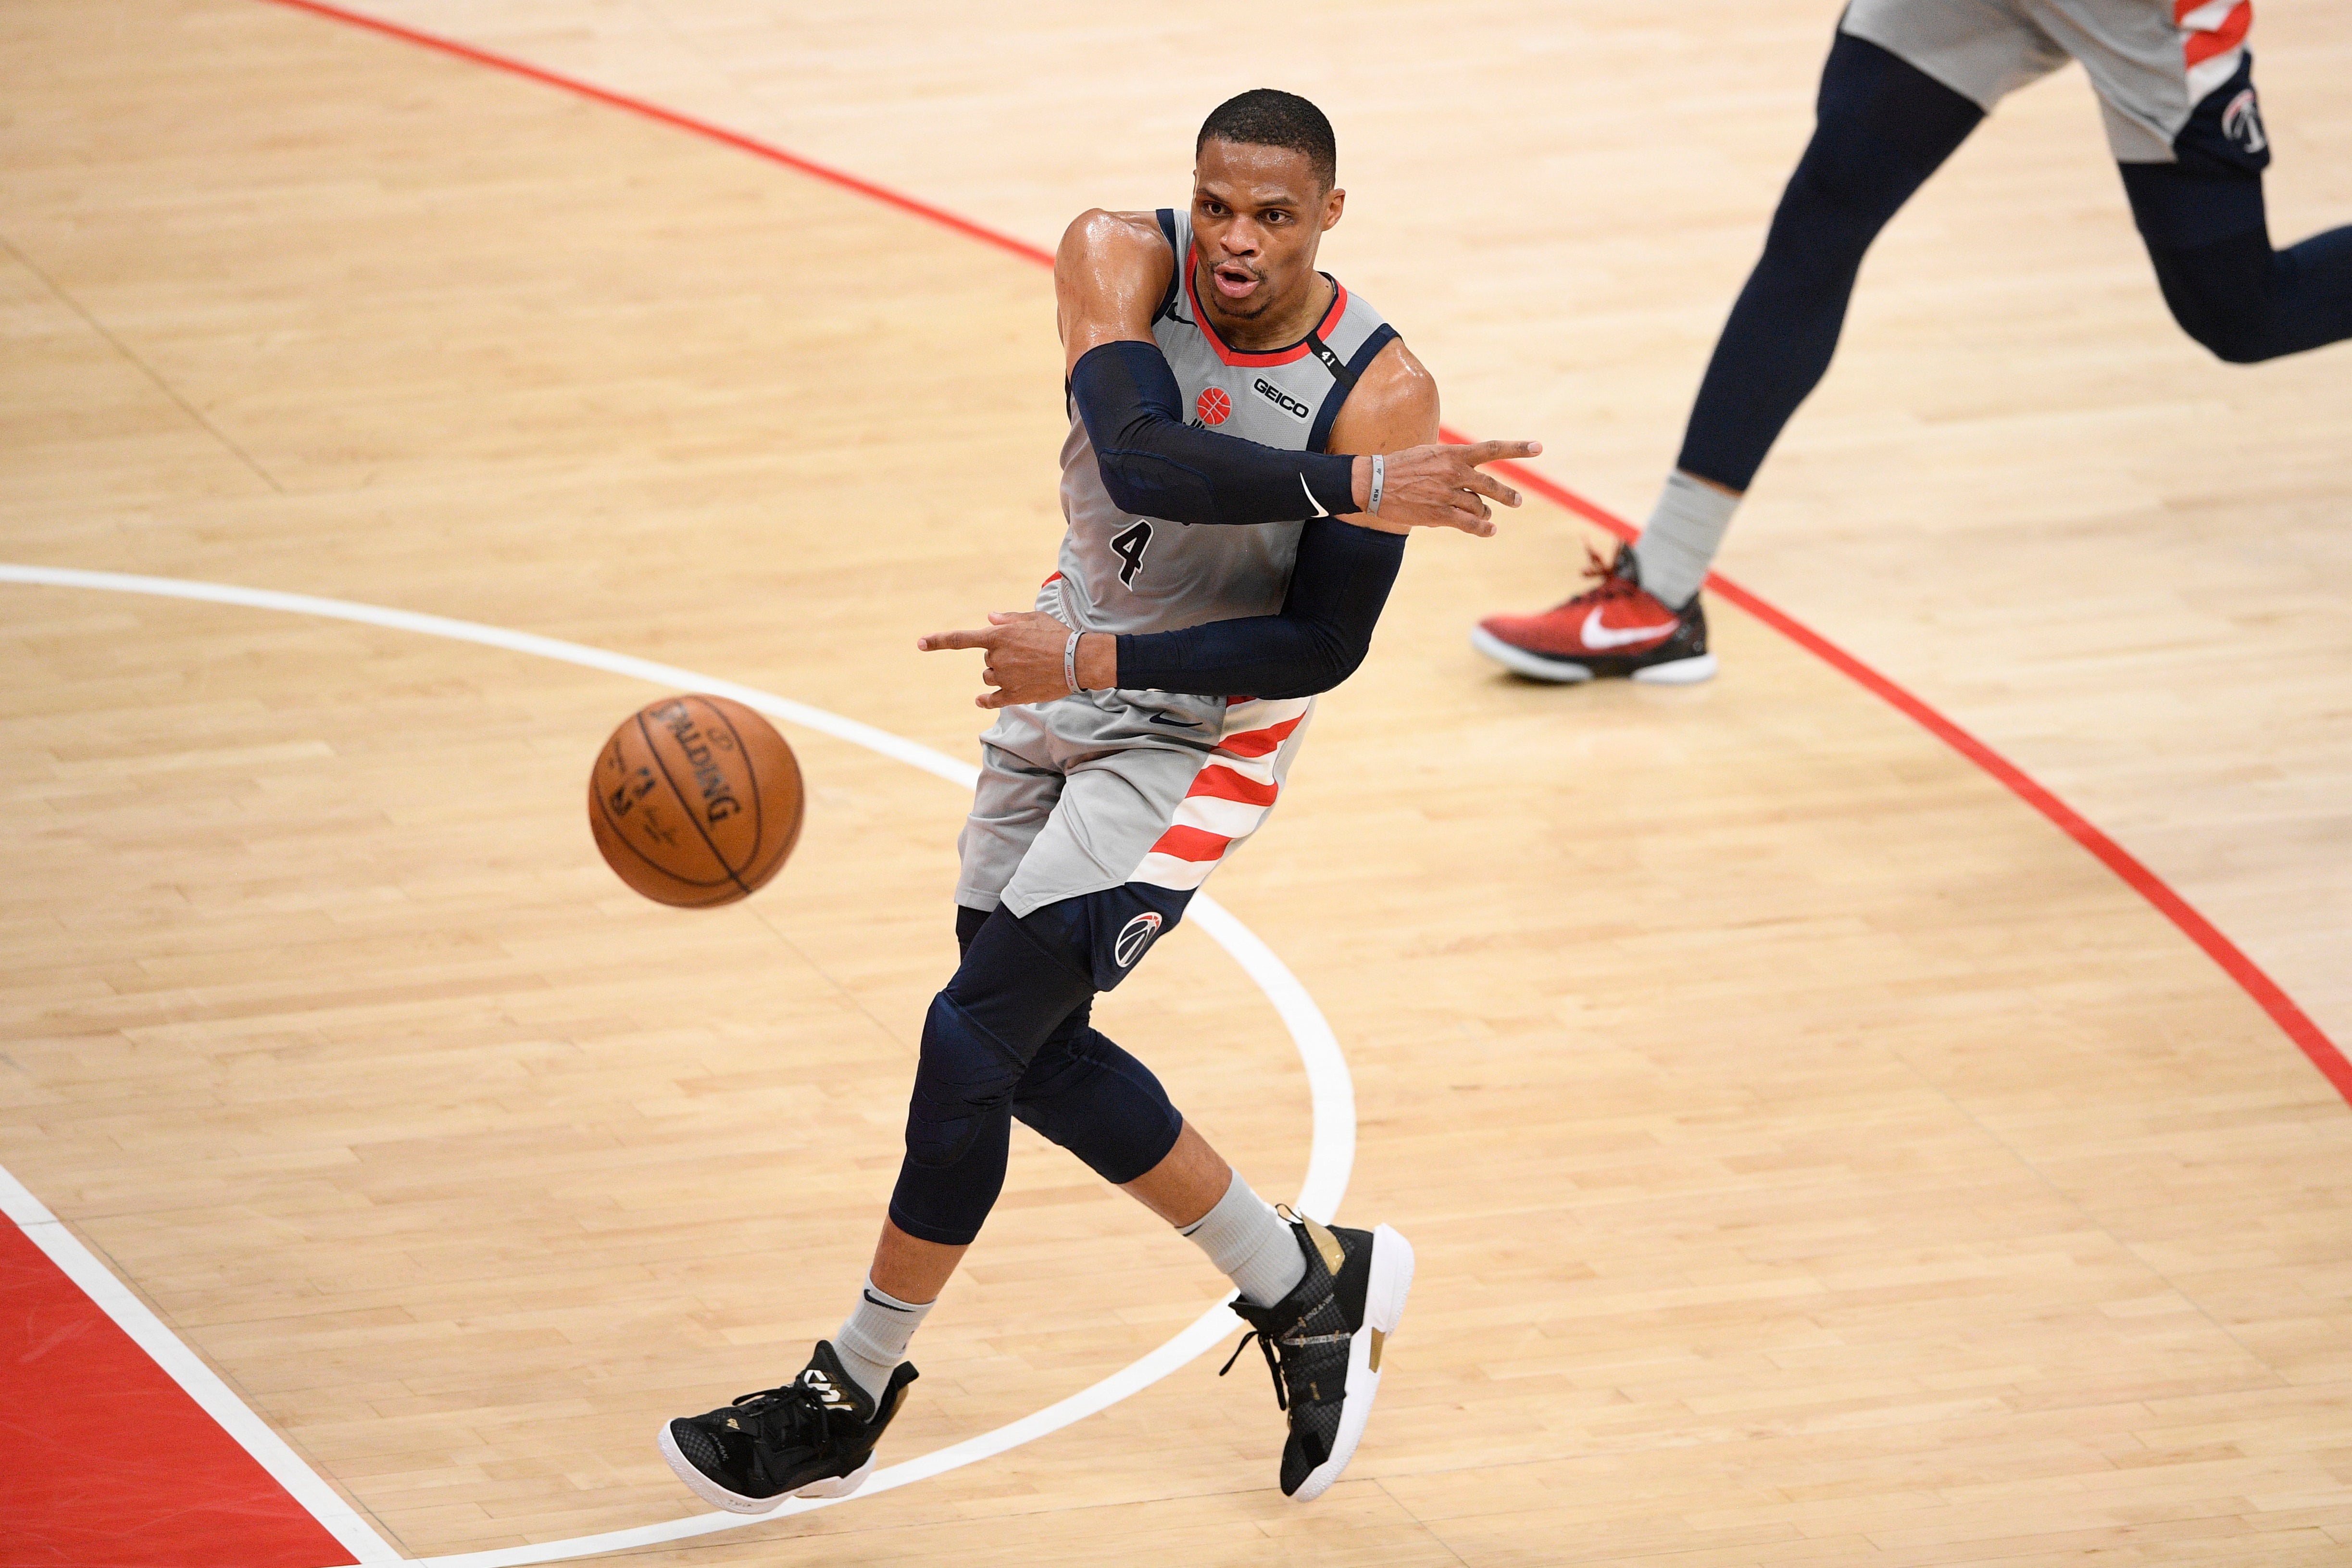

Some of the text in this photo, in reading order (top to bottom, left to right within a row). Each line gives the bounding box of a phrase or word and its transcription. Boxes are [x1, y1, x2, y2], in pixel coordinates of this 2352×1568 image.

[1322, 351, 1335, 366] 41
[1254, 378, 1309, 418] GEICO
[1109, 518, 1154, 591] 4
[650, 701, 741, 829] SPALDING
